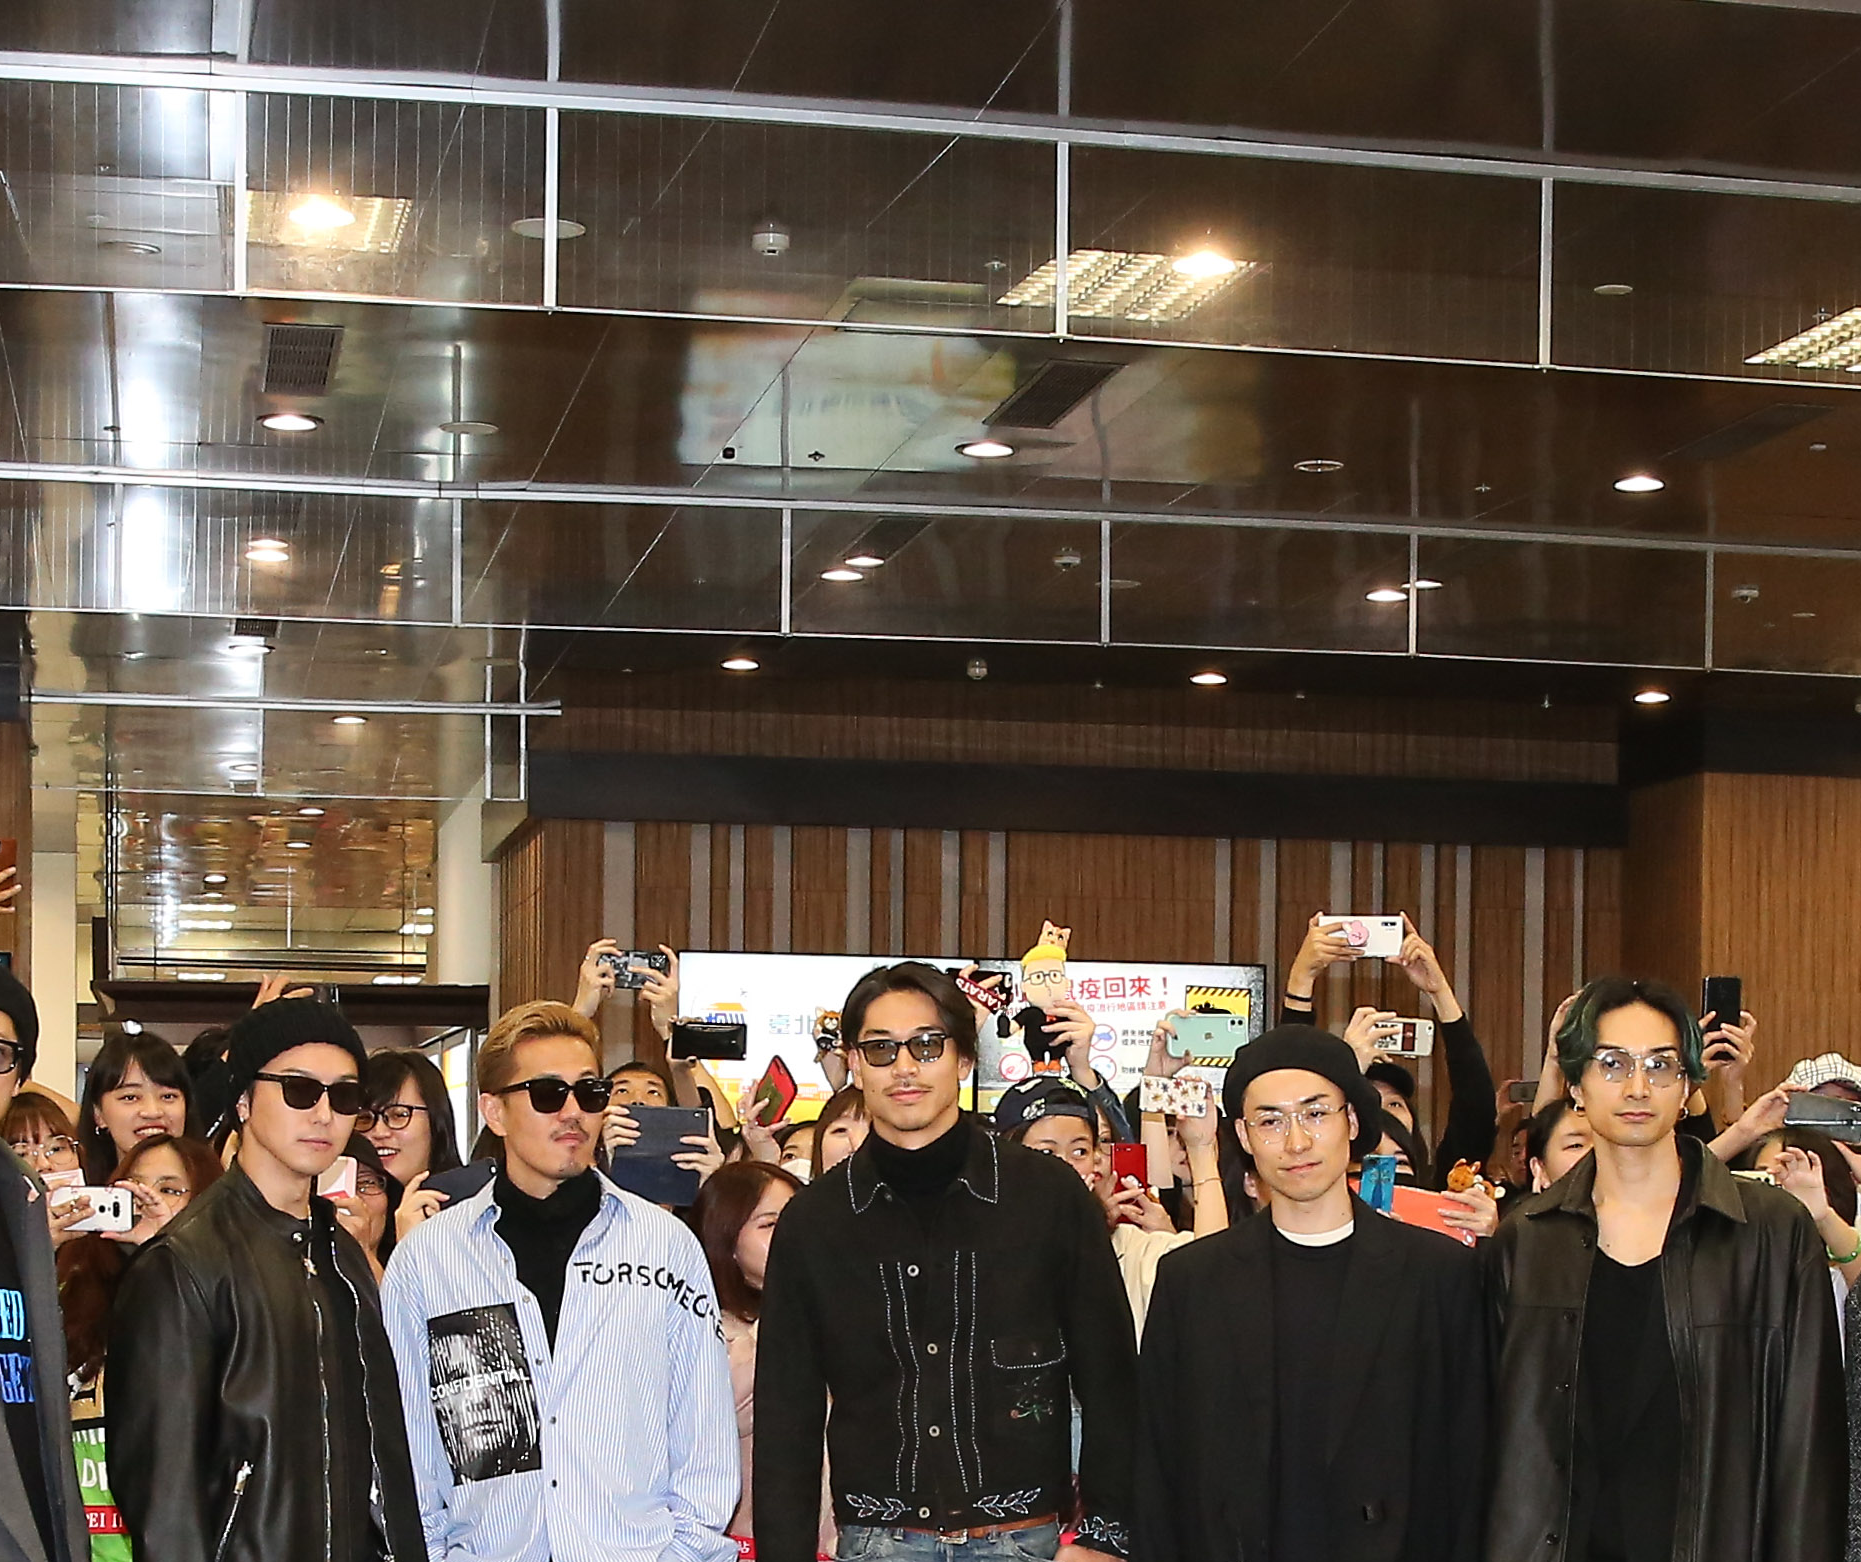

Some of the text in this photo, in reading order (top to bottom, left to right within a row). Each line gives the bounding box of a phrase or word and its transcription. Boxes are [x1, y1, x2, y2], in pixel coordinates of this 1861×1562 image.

[1066, 976, 1168, 1000] 疫回來！
[430, 1367, 530, 1401] CONFIDENTIAL
